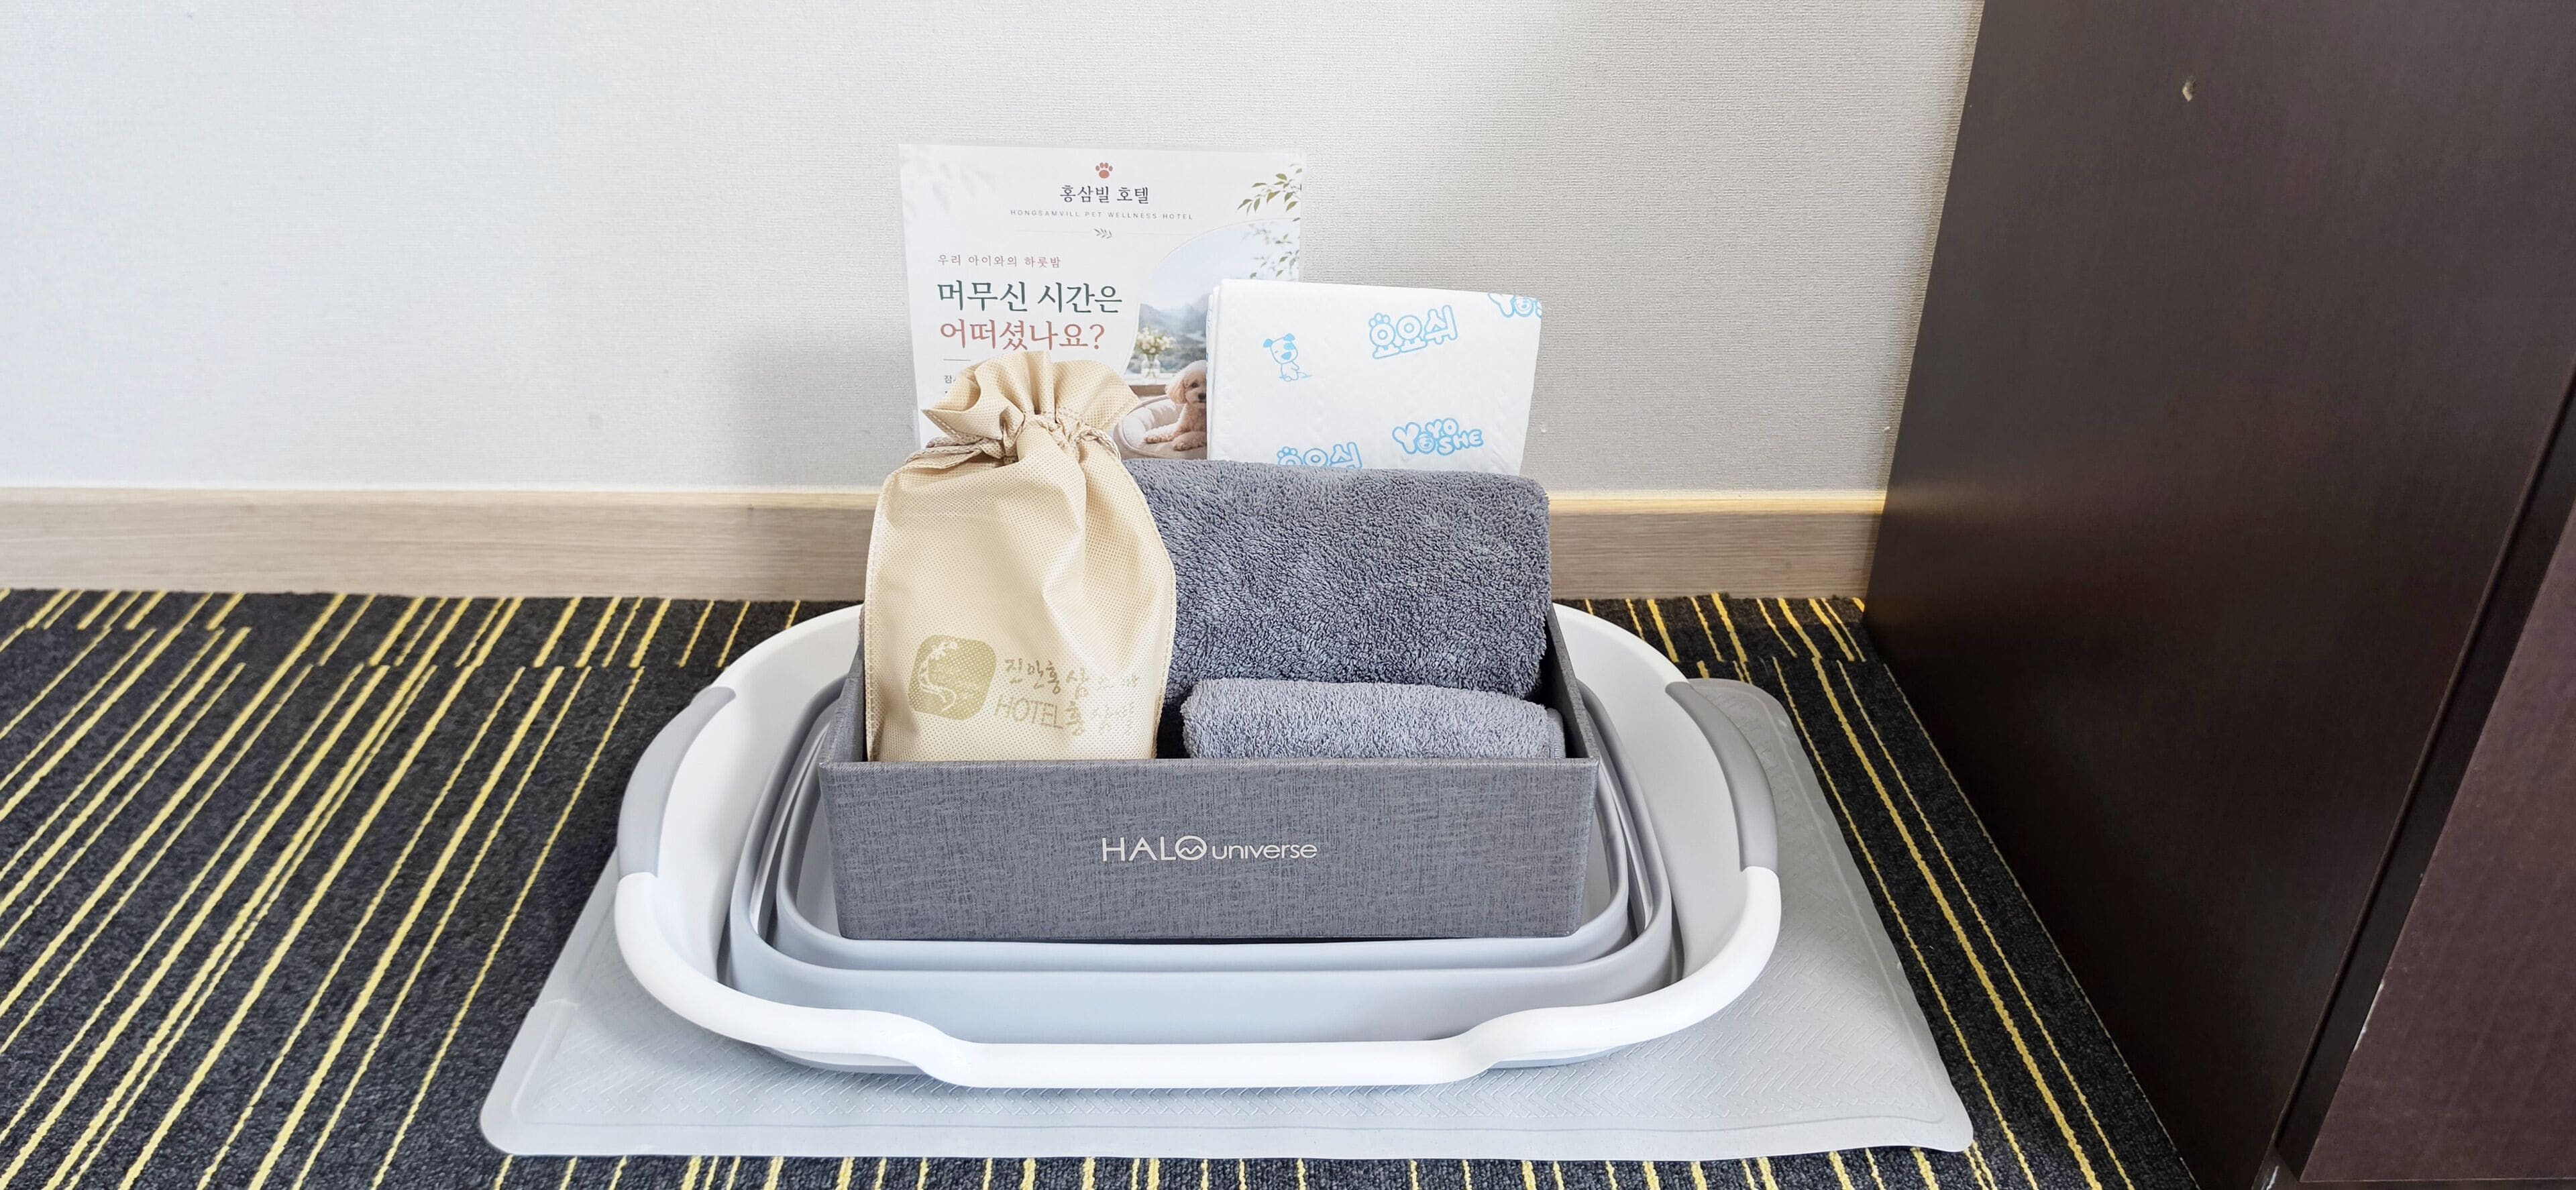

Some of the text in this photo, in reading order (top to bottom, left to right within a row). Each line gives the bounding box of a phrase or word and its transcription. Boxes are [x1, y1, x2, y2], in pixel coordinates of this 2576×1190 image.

[1059, 184, 1150, 205] 홍삼빌 호텔
[1010, 209, 1079, 218] HONGSAMVILL
[938, 254, 1061, 268] 우리 아이와의 하룻밤
[936, 279, 1122, 313] 머무신 시간은
[939, 318, 1106, 351] 어떠셨나요?
[1368, 305, 1458, 360] 요요쉬
[1102, 834, 1318, 861] HALO universe
